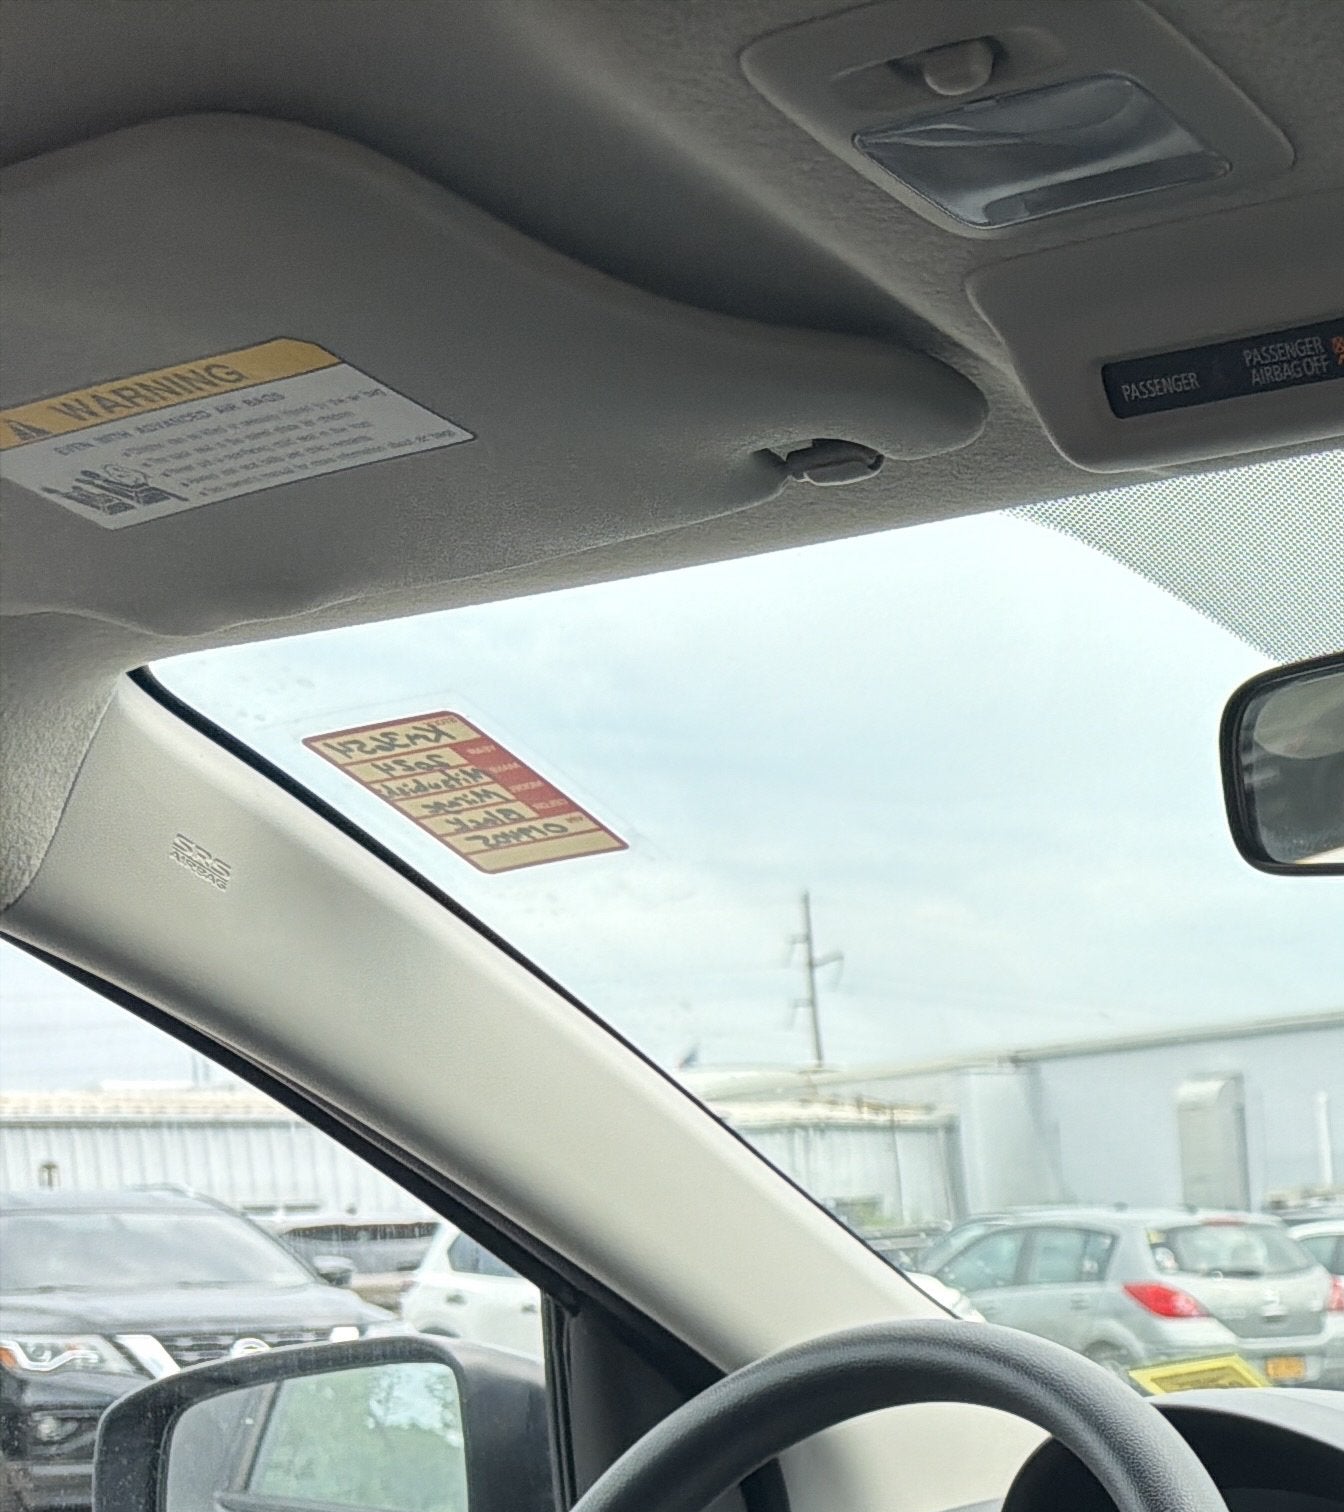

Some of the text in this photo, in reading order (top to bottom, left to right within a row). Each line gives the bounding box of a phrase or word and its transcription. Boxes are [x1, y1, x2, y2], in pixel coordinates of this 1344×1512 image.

[1242, 335, 1324, 367] PASSENGER
[1120, 371, 1200, 401] PASSENGER
[1250, 354, 1331, 387] AIRBAG OFF
[47, 363, 248, 422] WARNING
